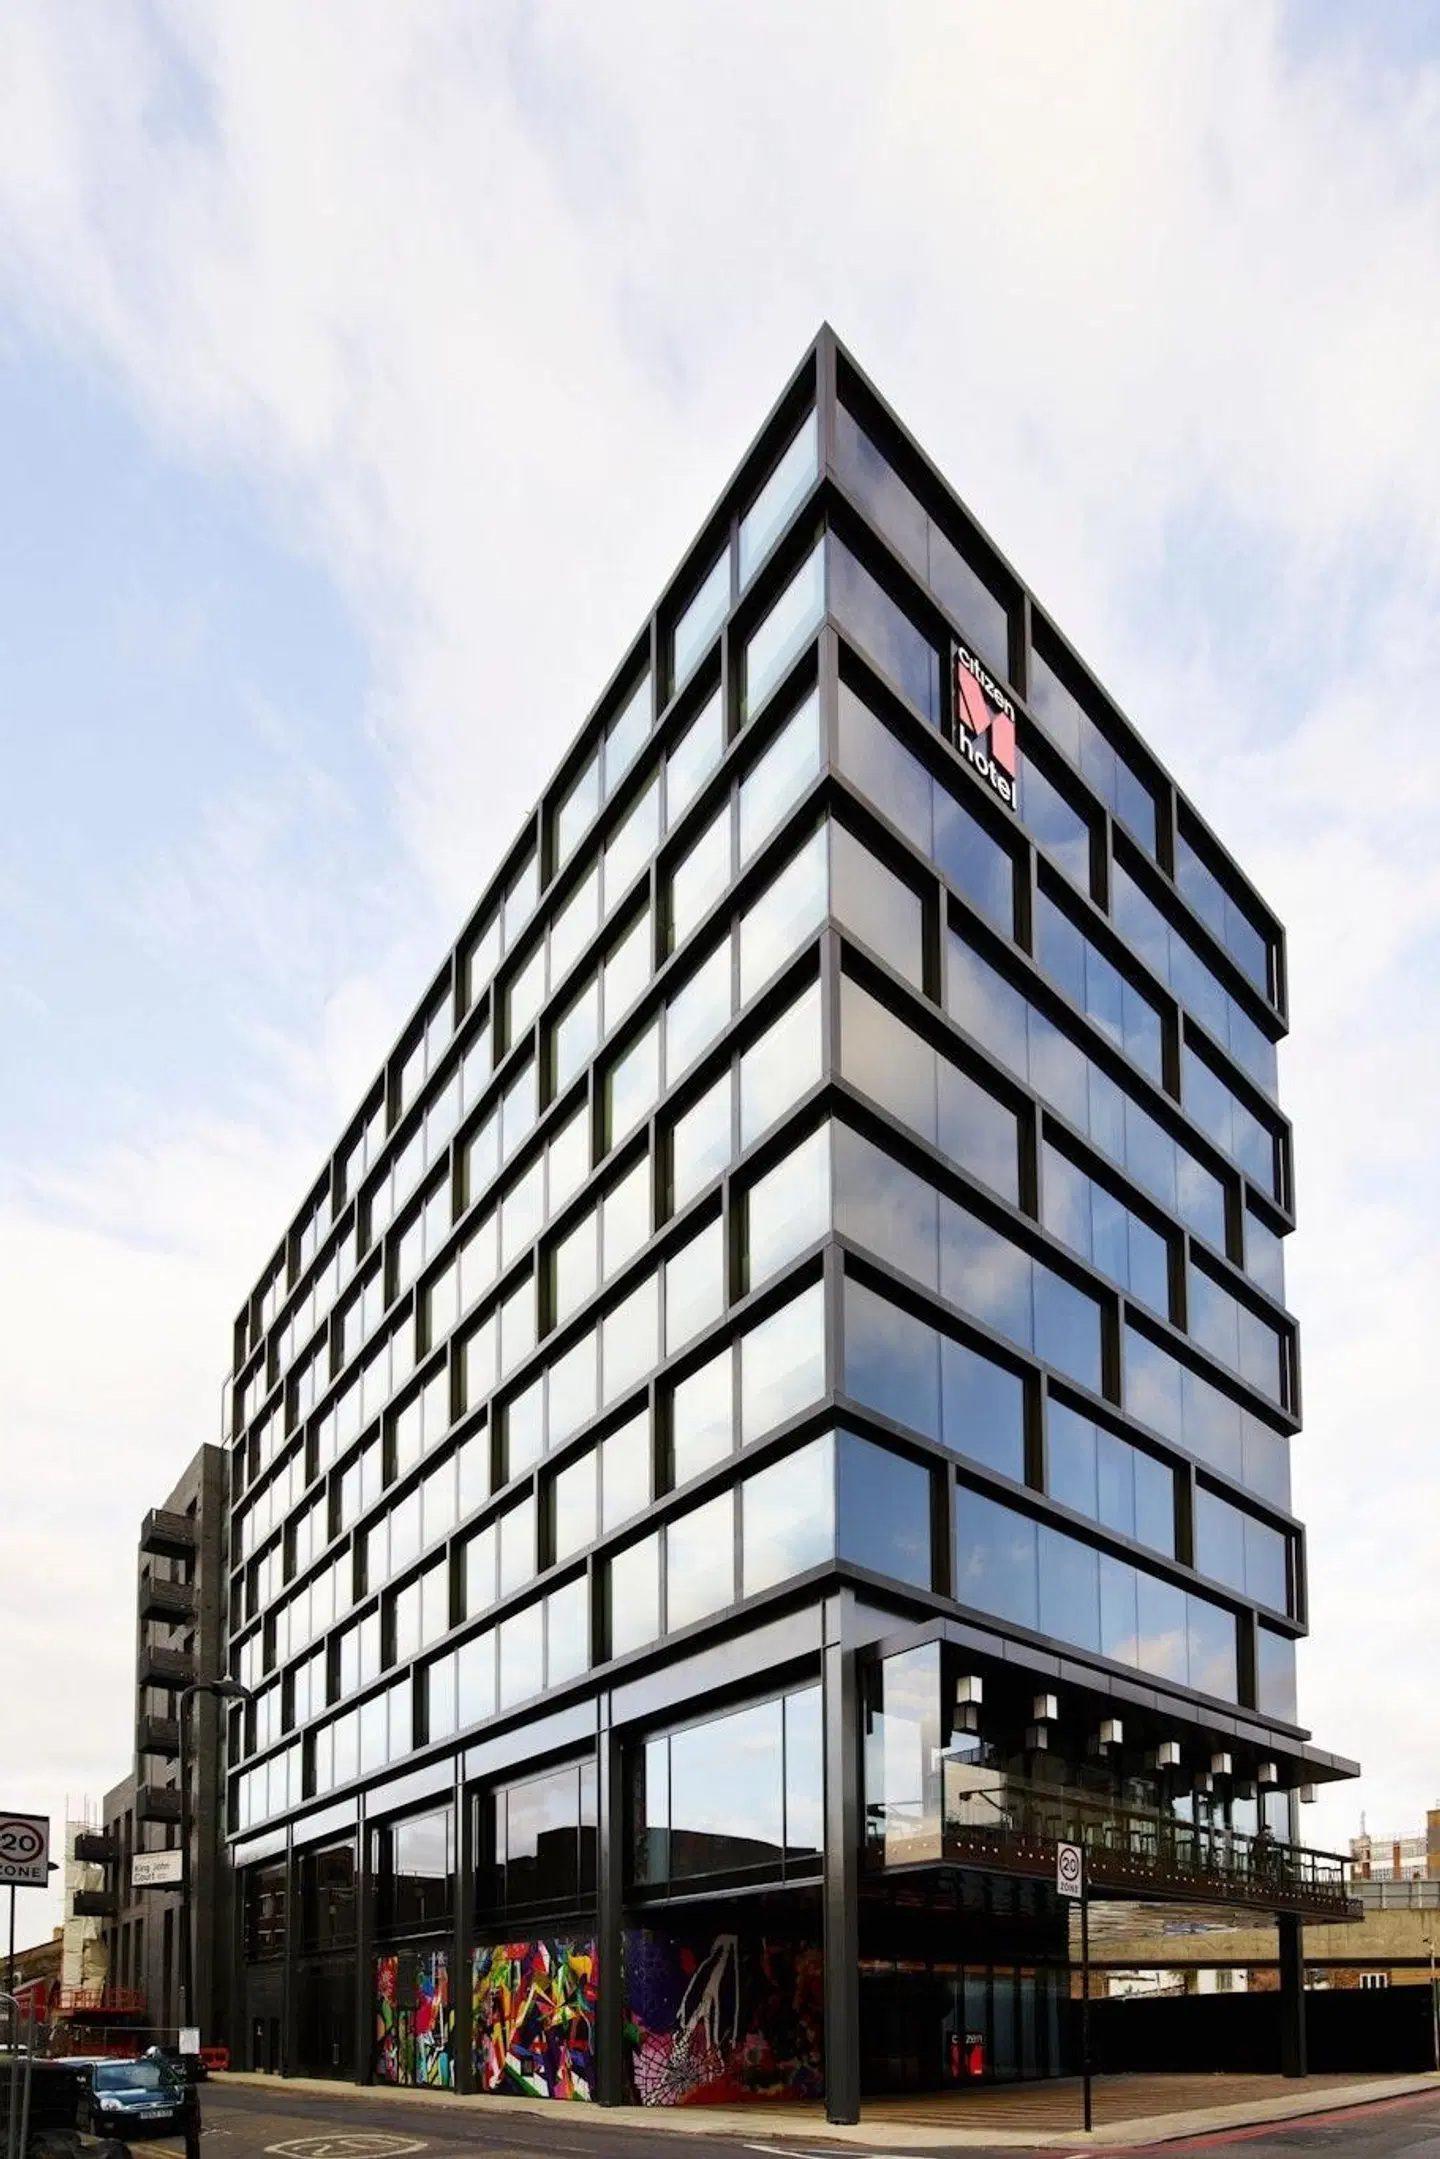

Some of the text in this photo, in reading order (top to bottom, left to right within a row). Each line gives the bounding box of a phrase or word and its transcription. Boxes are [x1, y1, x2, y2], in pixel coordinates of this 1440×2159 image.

[958, 647, 1015, 722] citizen
[959, 723, 1016, 809] hotel
[1, 1833, 36, 1852] 20
[0, 1865, 41, 1877] ONE
[1062, 1857, 1076, 1872] 20
[1060, 1881, 1079, 1893] ZONE
